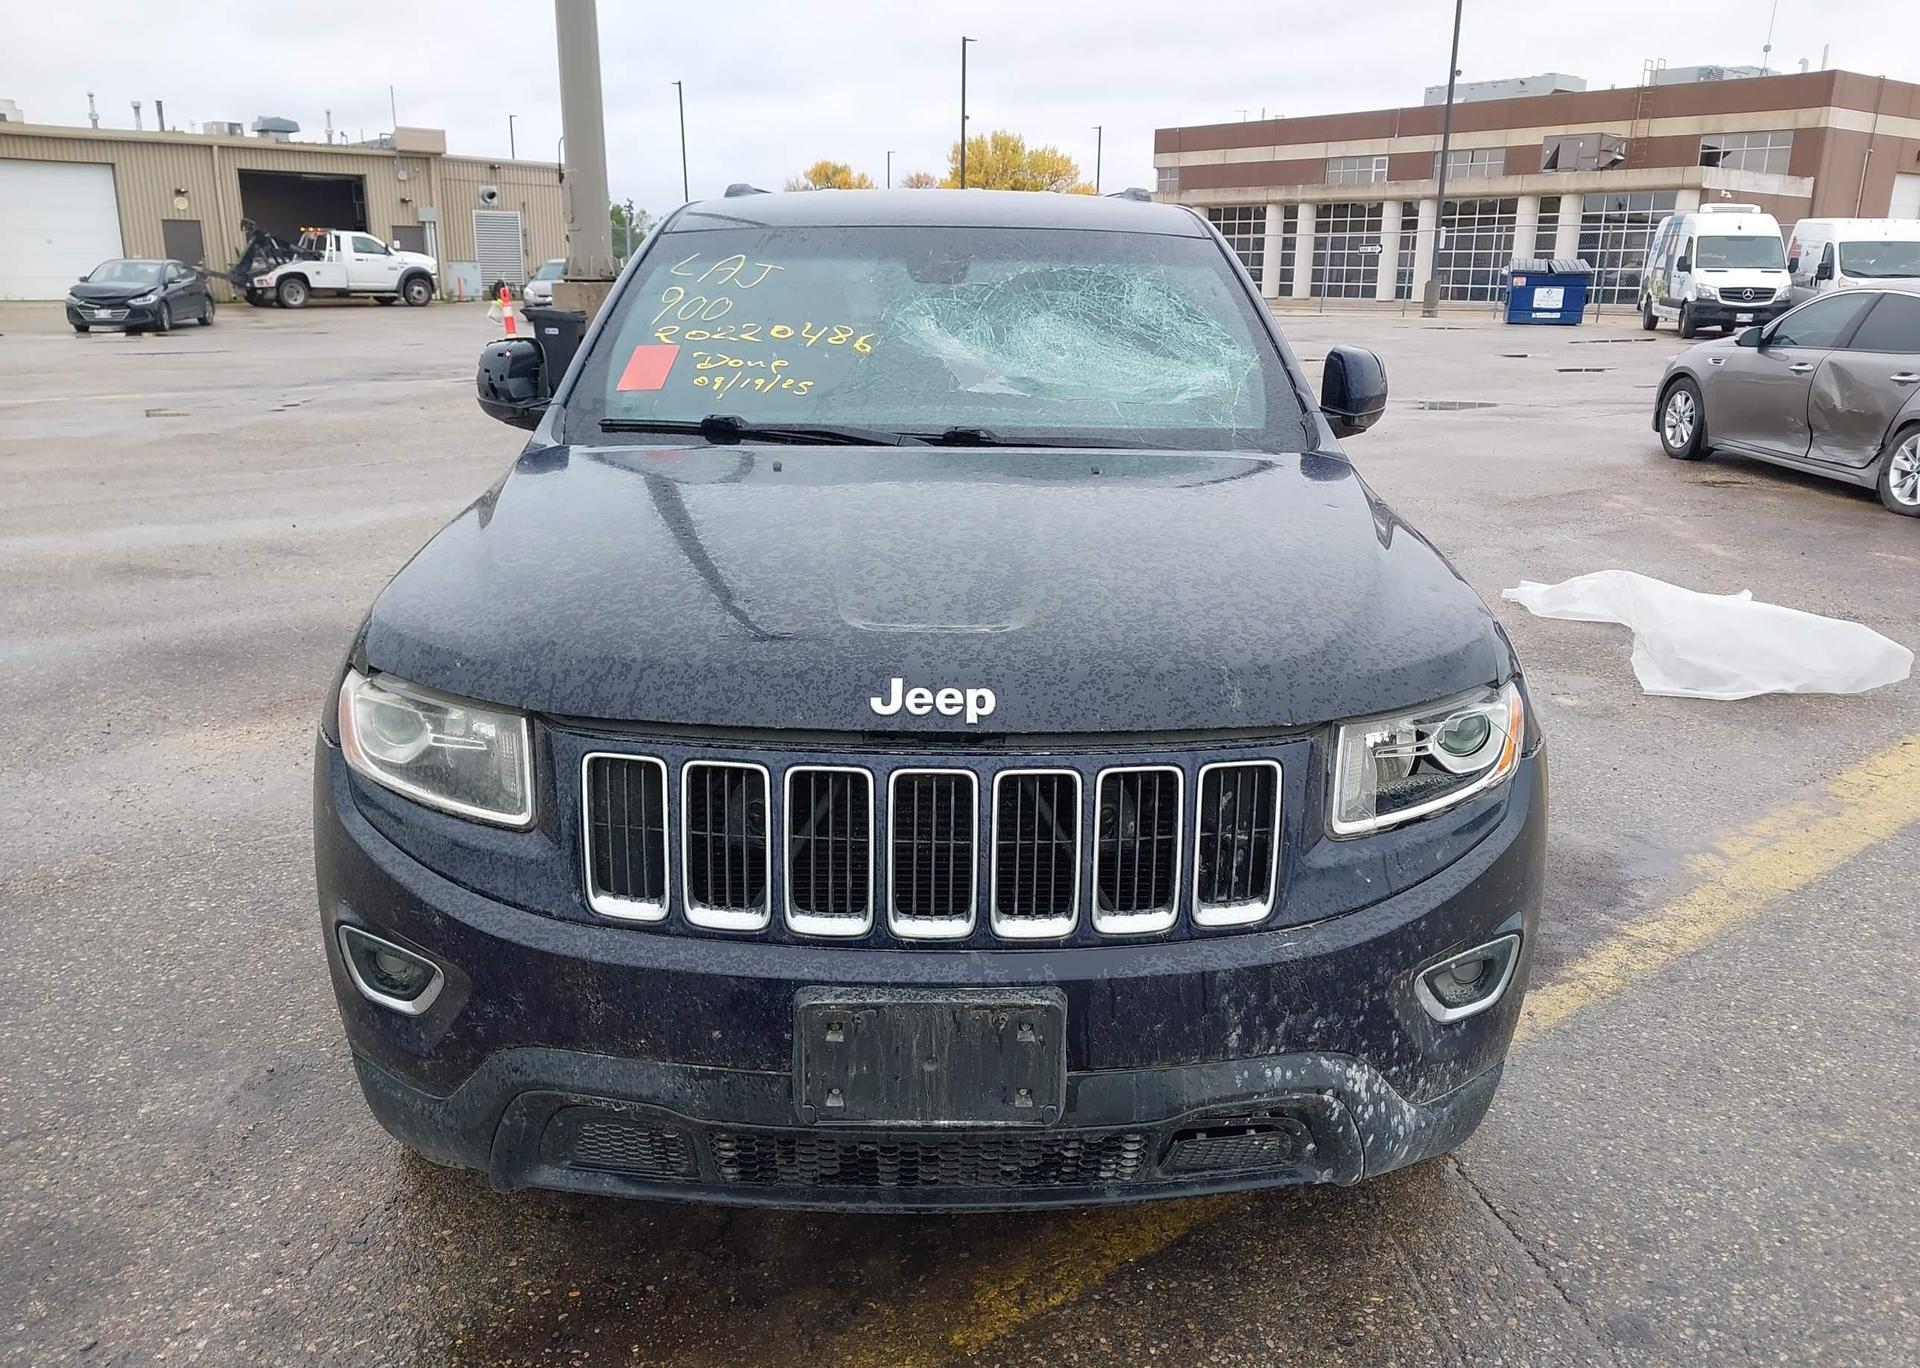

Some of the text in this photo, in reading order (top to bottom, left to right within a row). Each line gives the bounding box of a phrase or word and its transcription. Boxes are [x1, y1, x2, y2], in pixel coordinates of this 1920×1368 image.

[651, 286, 733, 326] 900
[654, 322, 876, 352] 20220486
[869, 676, 997, 725] Jeep
